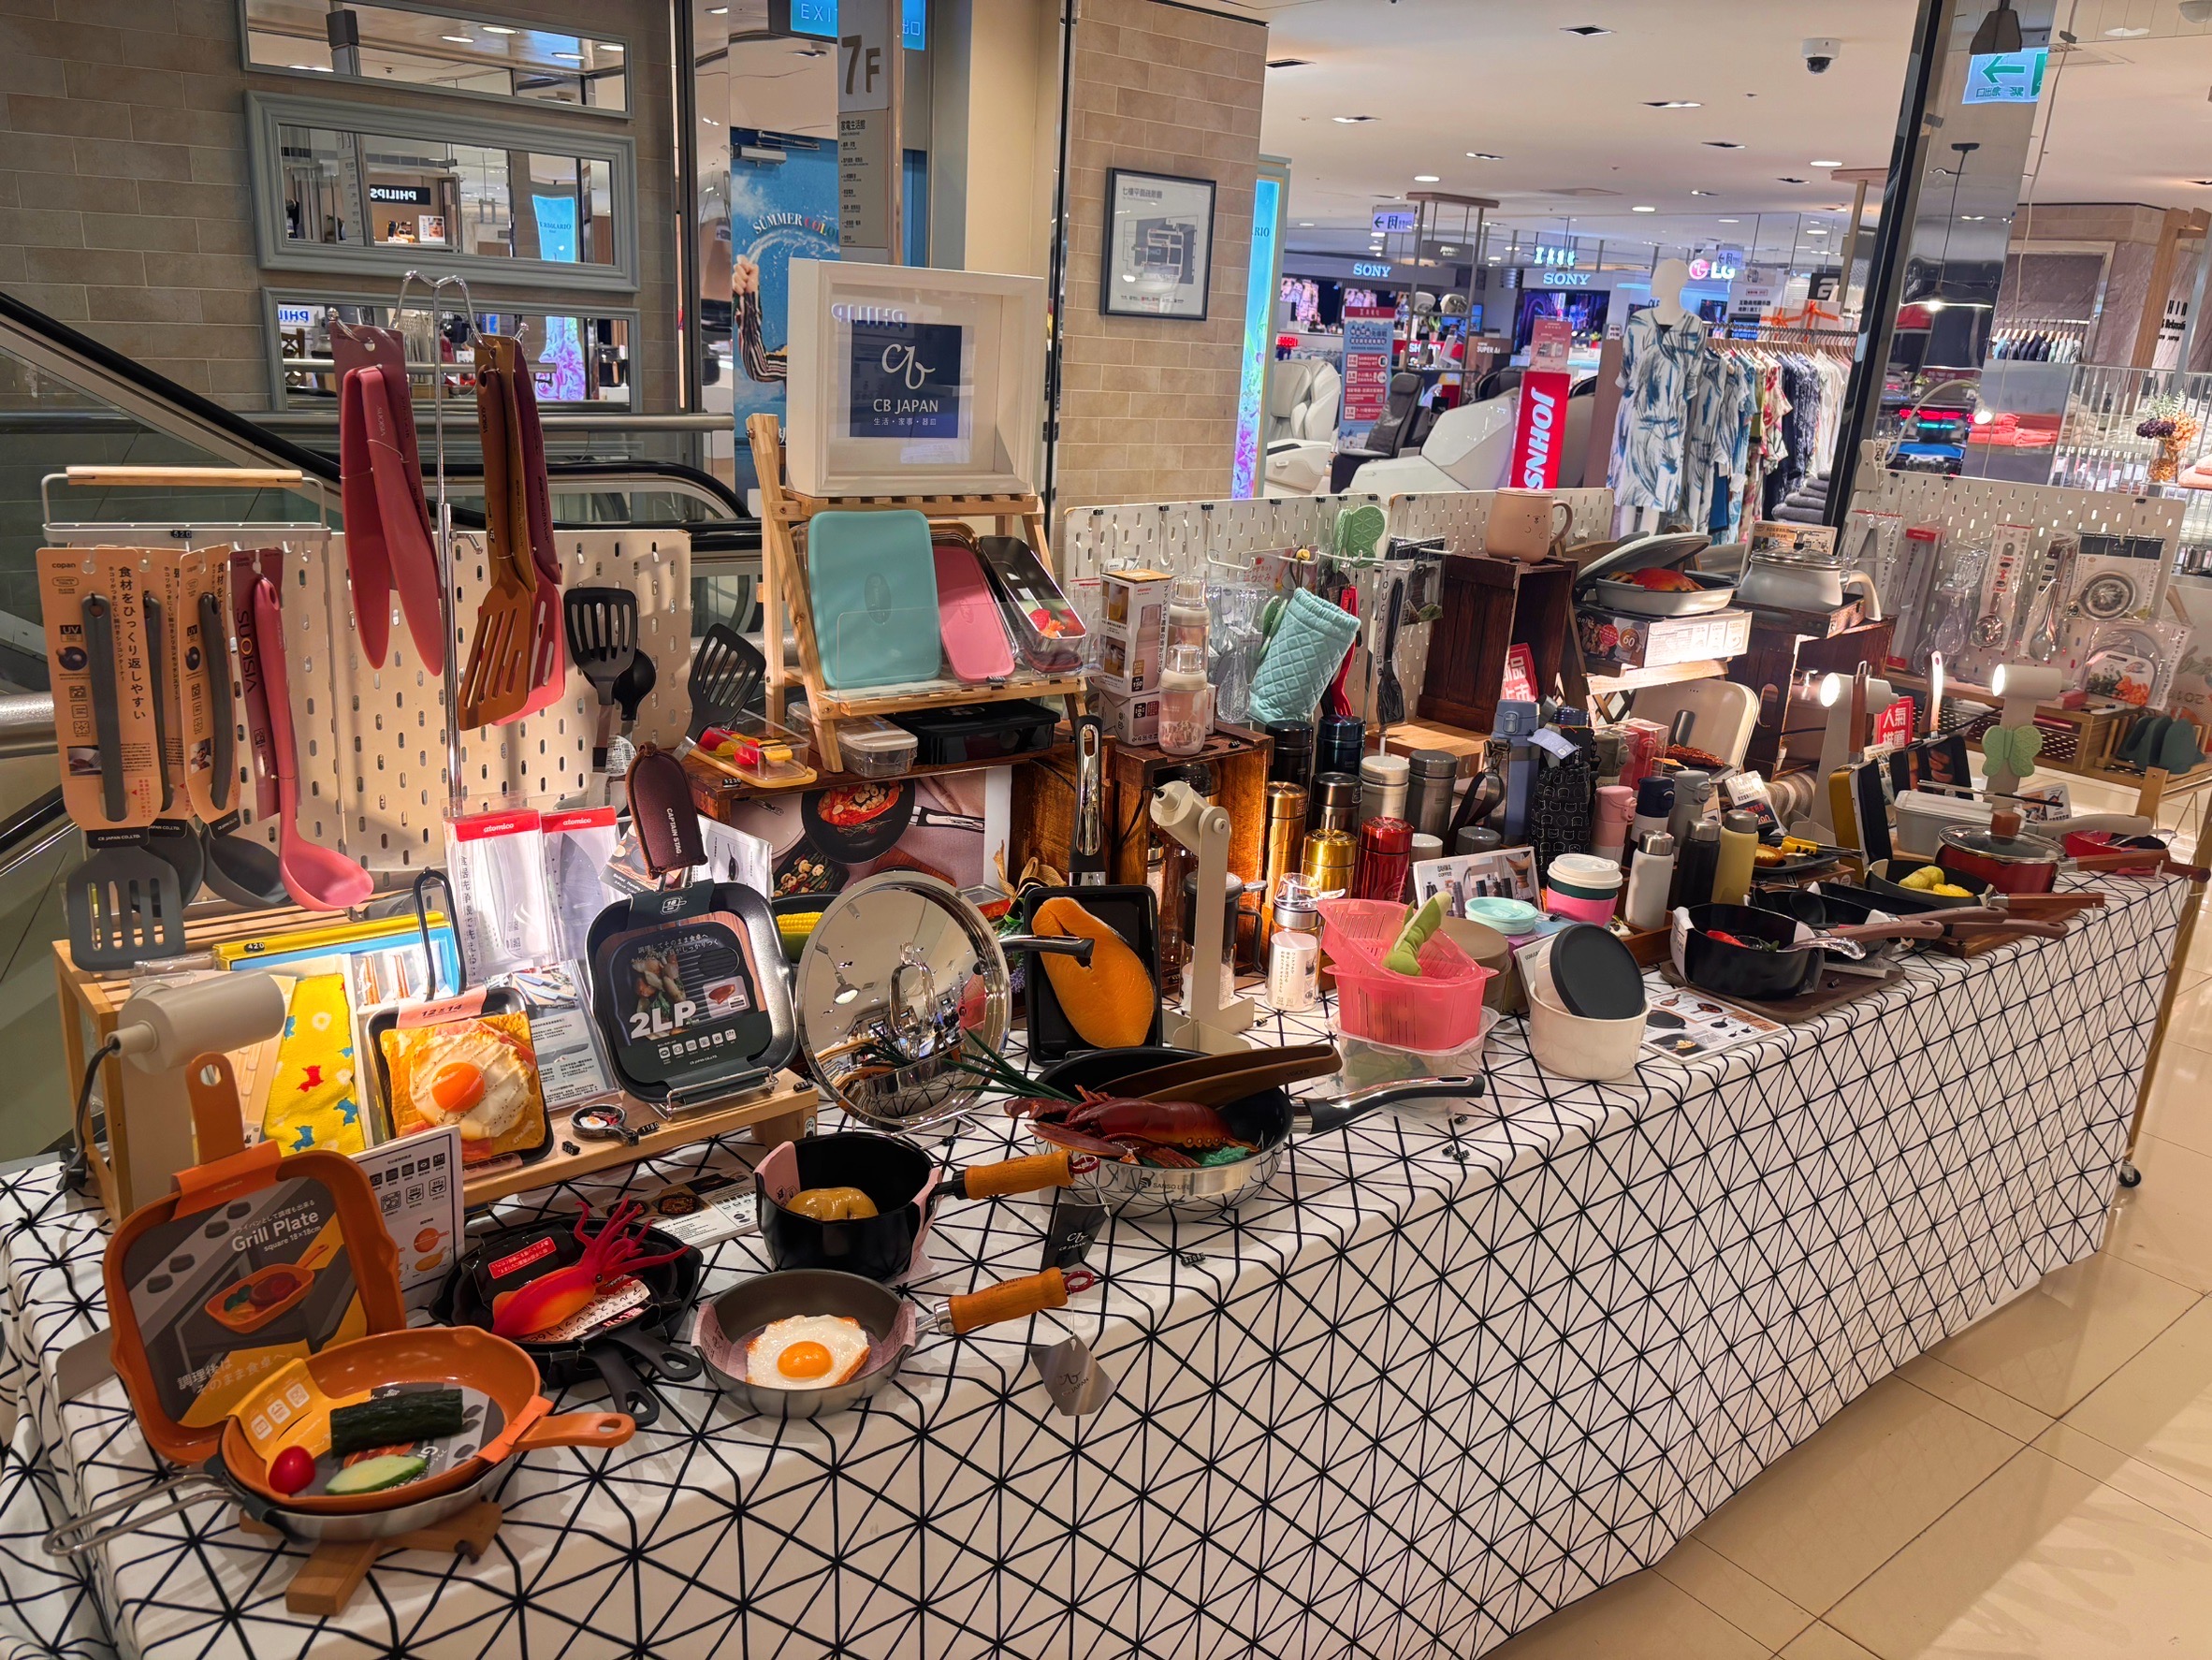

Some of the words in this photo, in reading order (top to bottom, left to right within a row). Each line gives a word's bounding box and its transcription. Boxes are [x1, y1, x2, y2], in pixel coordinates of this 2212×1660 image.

[801, 3, 838, 22] EXI
[842, 35, 880, 95] 7F
[752, 211, 803, 235] SUMMER
[804, 216, 838, 239] COLO
[1353, 263, 1392, 278] SONY
[1543, 272, 1591, 285] SONY
[1710, 261, 1736, 280] LG
[873, 400, 891, 413] CB
[895, 400, 939, 415] JAPAN
[1378, 569, 1390, 623] TOUCH
[118, 566, 146, 720] 食材をひっくり返しやすい
[236, 609, 258, 693] VISIONS
[1623, 635, 1636, 648] 60
[1883, 706, 1906, 728] 人氣
[483, 823, 515, 833] atomico
[563, 817, 591, 826] atomico
[666, 808, 678, 837] CAPTAIN
[674, 836, 683, 855] STAG
[629, 999, 697, 1040] 2LP
[231, 1227, 269, 1253] Grill
[273, 1211, 320, 1237] Plate
[264, 1237, 289, 1253] square
[177, 1359, 233, 1391] 調理後は
